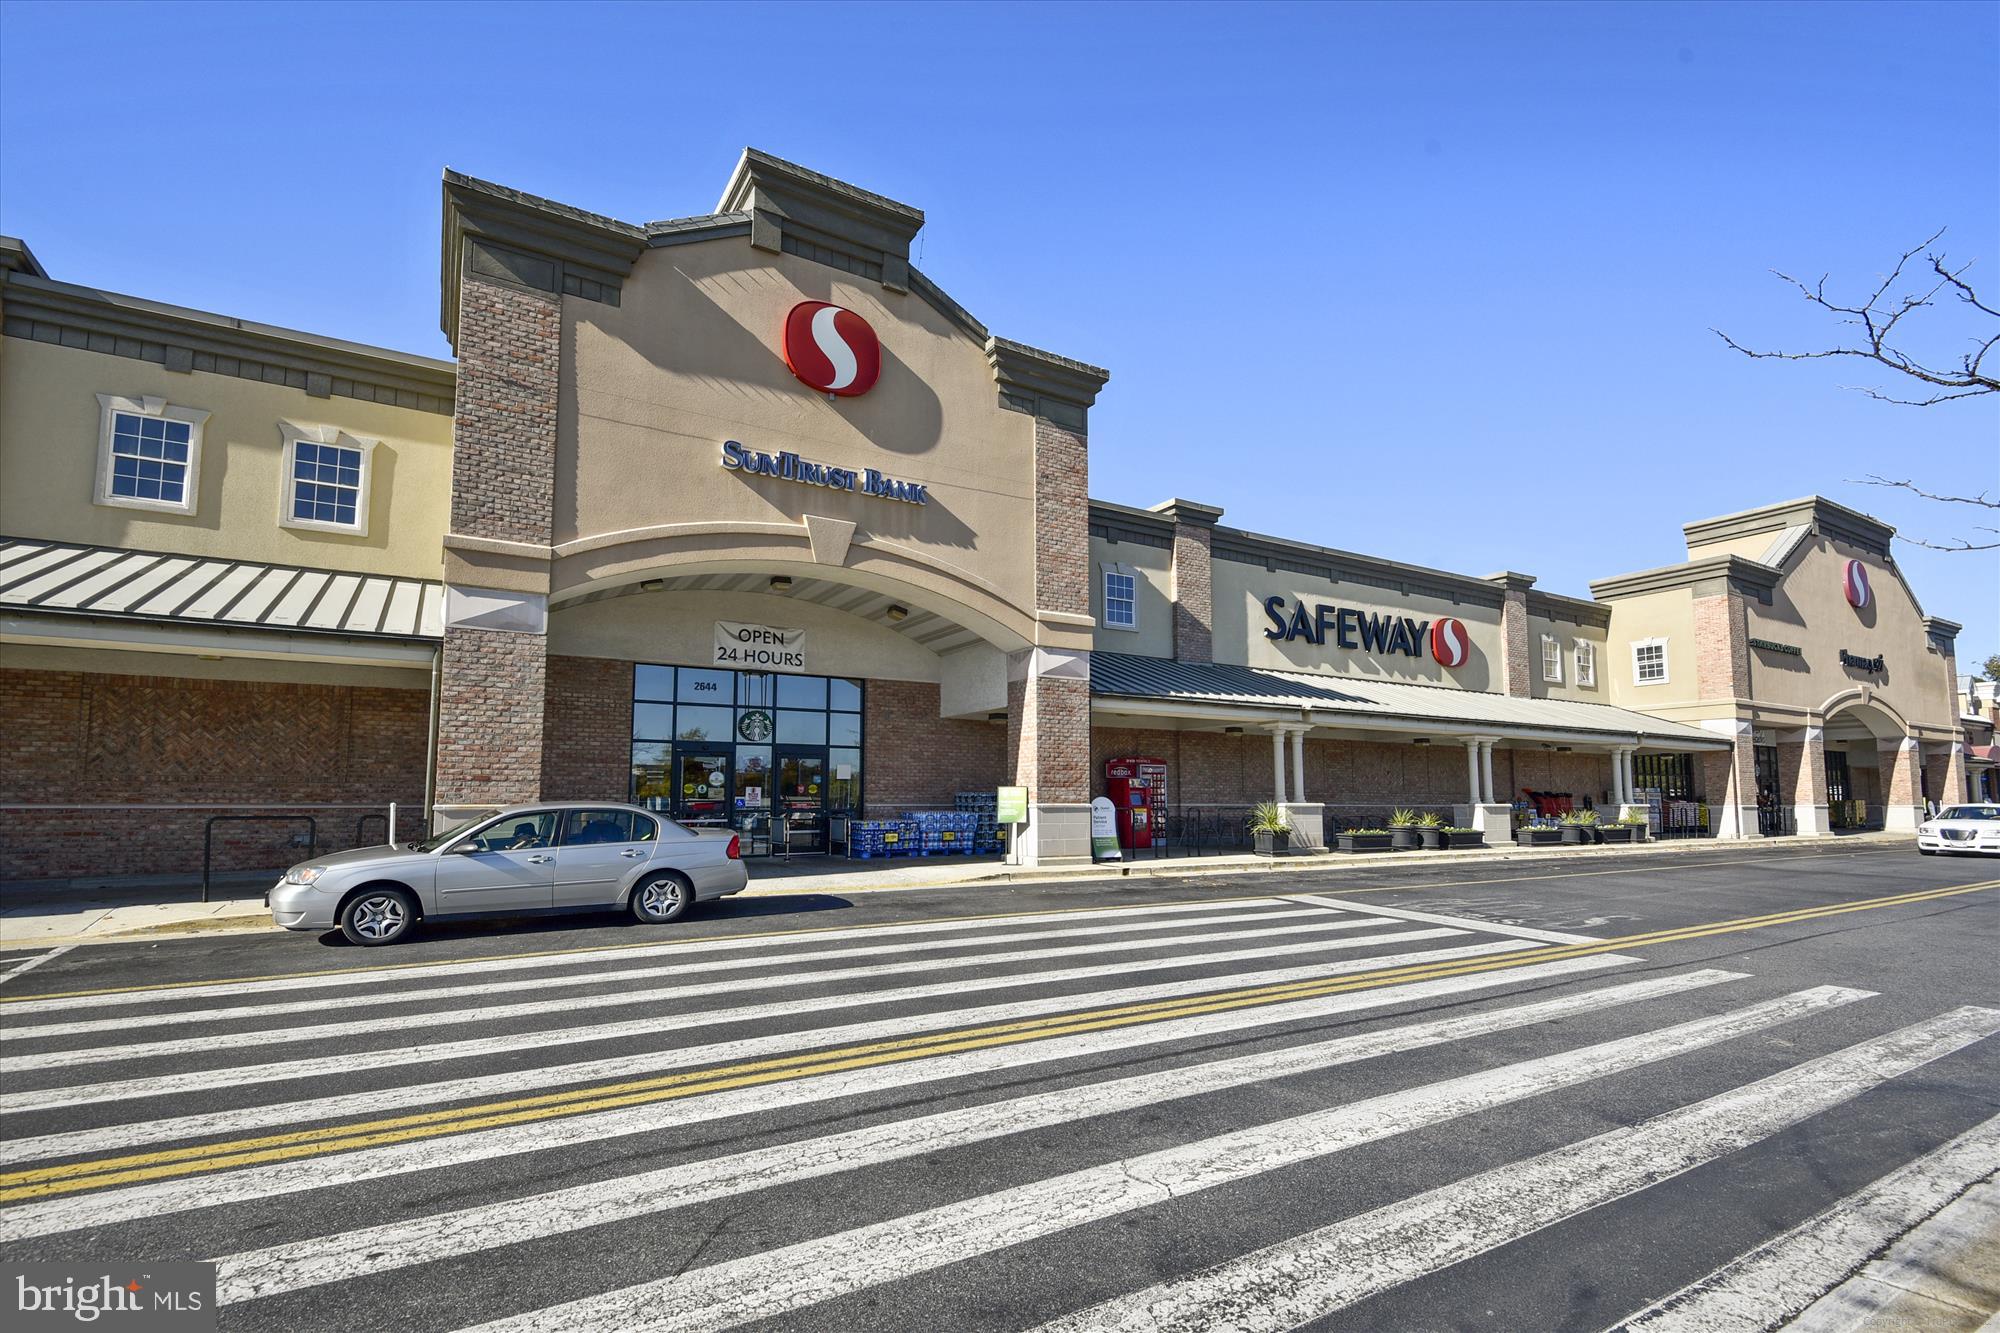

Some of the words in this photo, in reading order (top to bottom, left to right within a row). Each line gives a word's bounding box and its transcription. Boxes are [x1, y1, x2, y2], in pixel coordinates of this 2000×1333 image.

[861, 468, 928, 506] BANK
[1264, 595, 1429, 658] SAFEWAY
[738, 628, 784, 646] OPEN
[717, 646, 737, 661] 24
[744, 649, 803, 667] HOURS
[694, 681, 717, 691] 2644
[1111, 767, 1132, 776] redbox
